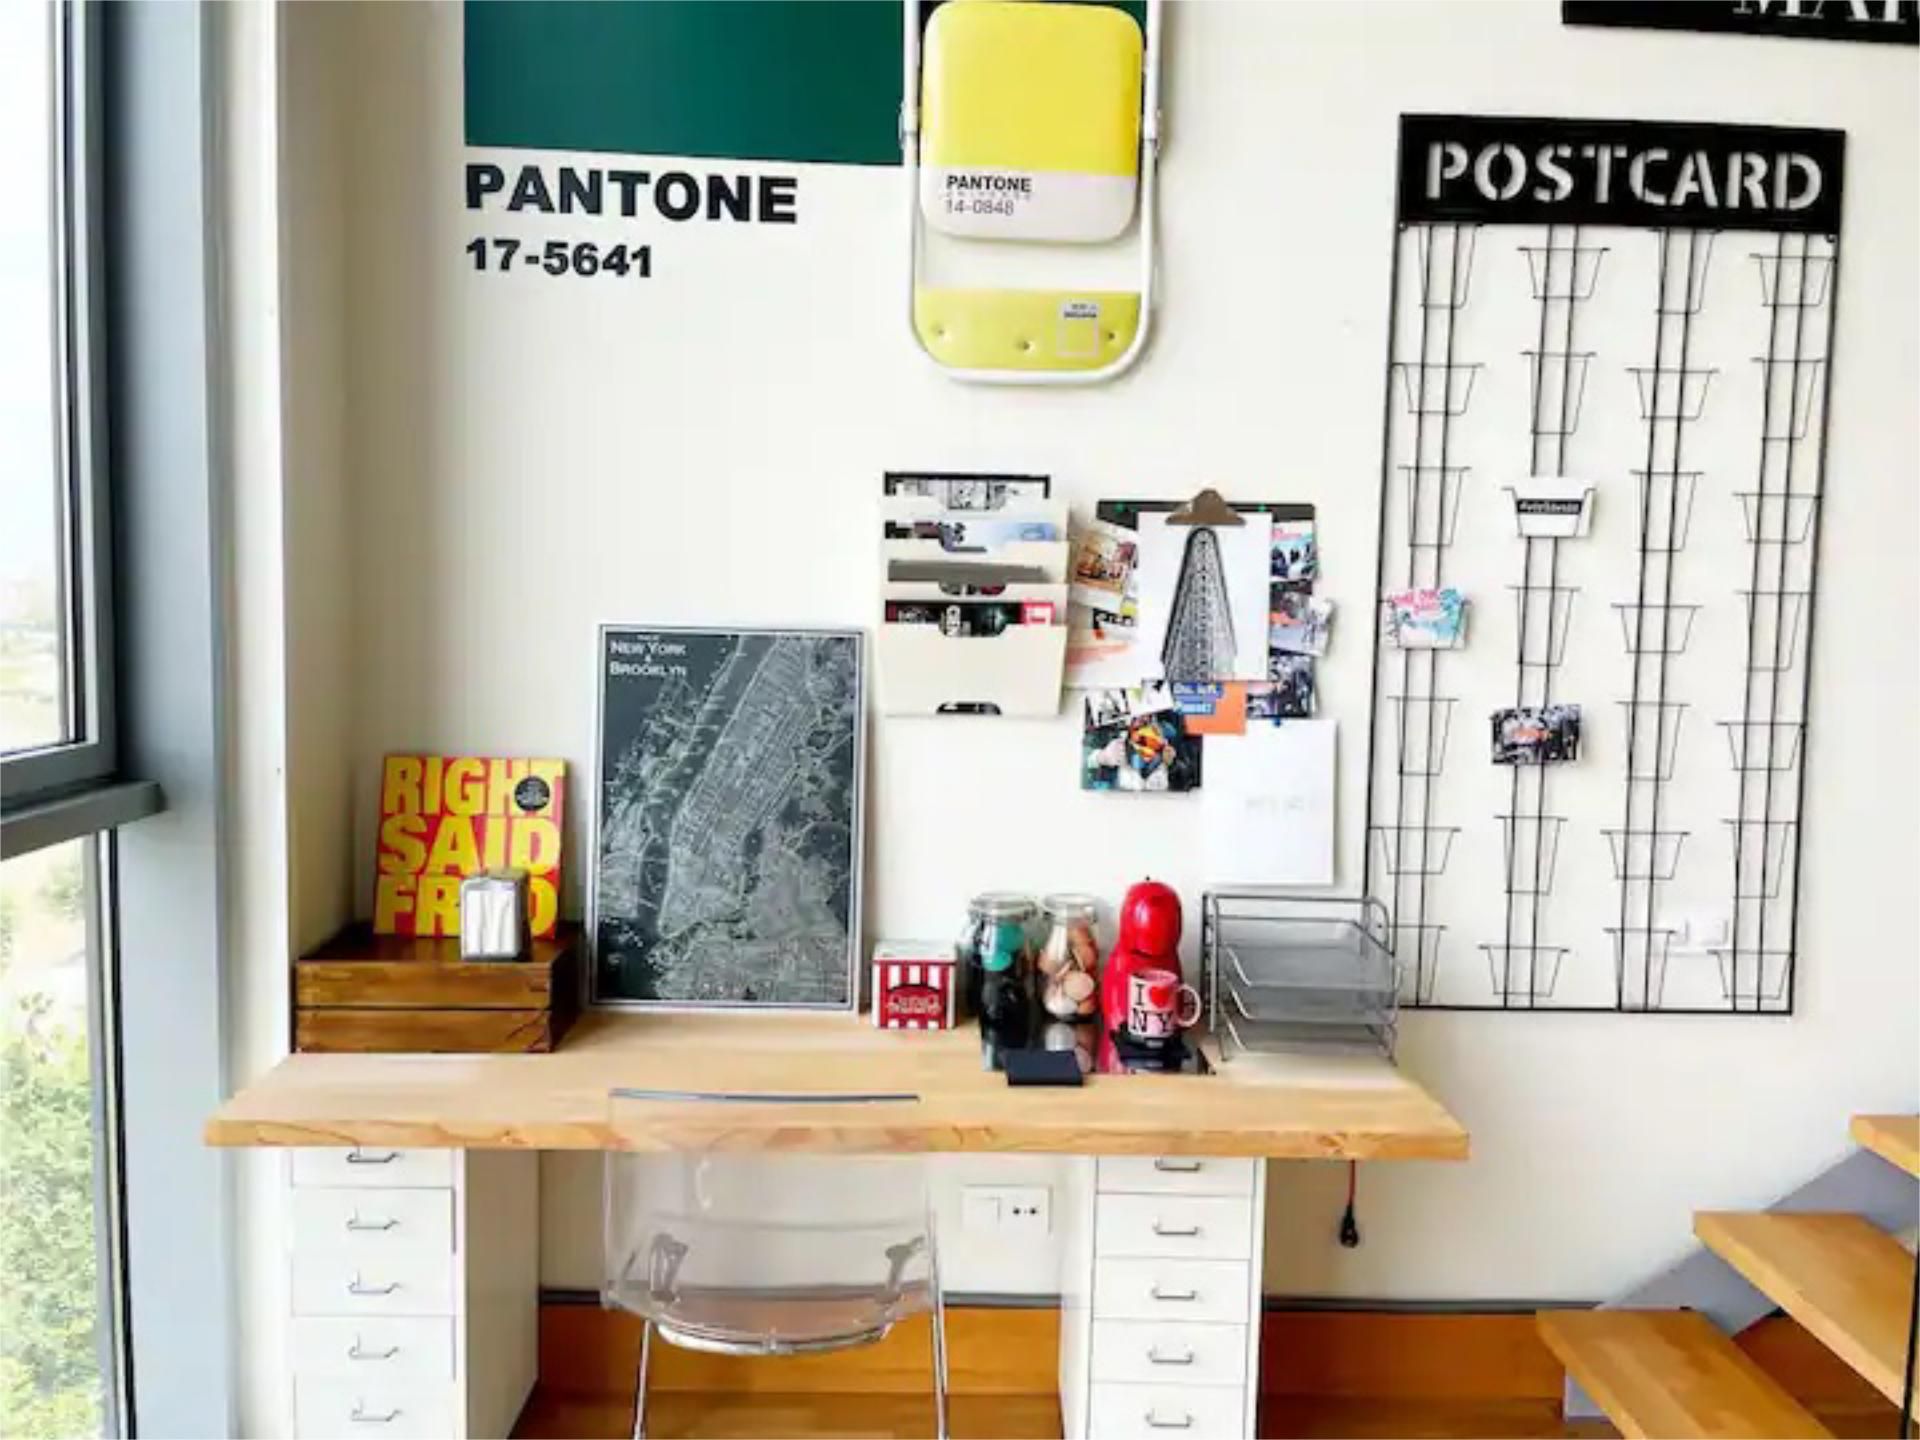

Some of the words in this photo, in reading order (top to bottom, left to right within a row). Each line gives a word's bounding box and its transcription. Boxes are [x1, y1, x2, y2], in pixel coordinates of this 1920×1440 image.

[465, 162, 798, 224] PANTONE
[946, 174, 1032, 192] PANTONE
[1426, 141, 1823, 211] POSTCARD
[946, 199, 1014, 216] 14-0848
[465, 237, 652, 278] 17-5641
[384, 757, 566, 816] RIGHT
[379, 815, 561, 876] SAID
[373, 873, 558, 937] FRD
[1135, 984, 1145, 1006] I
